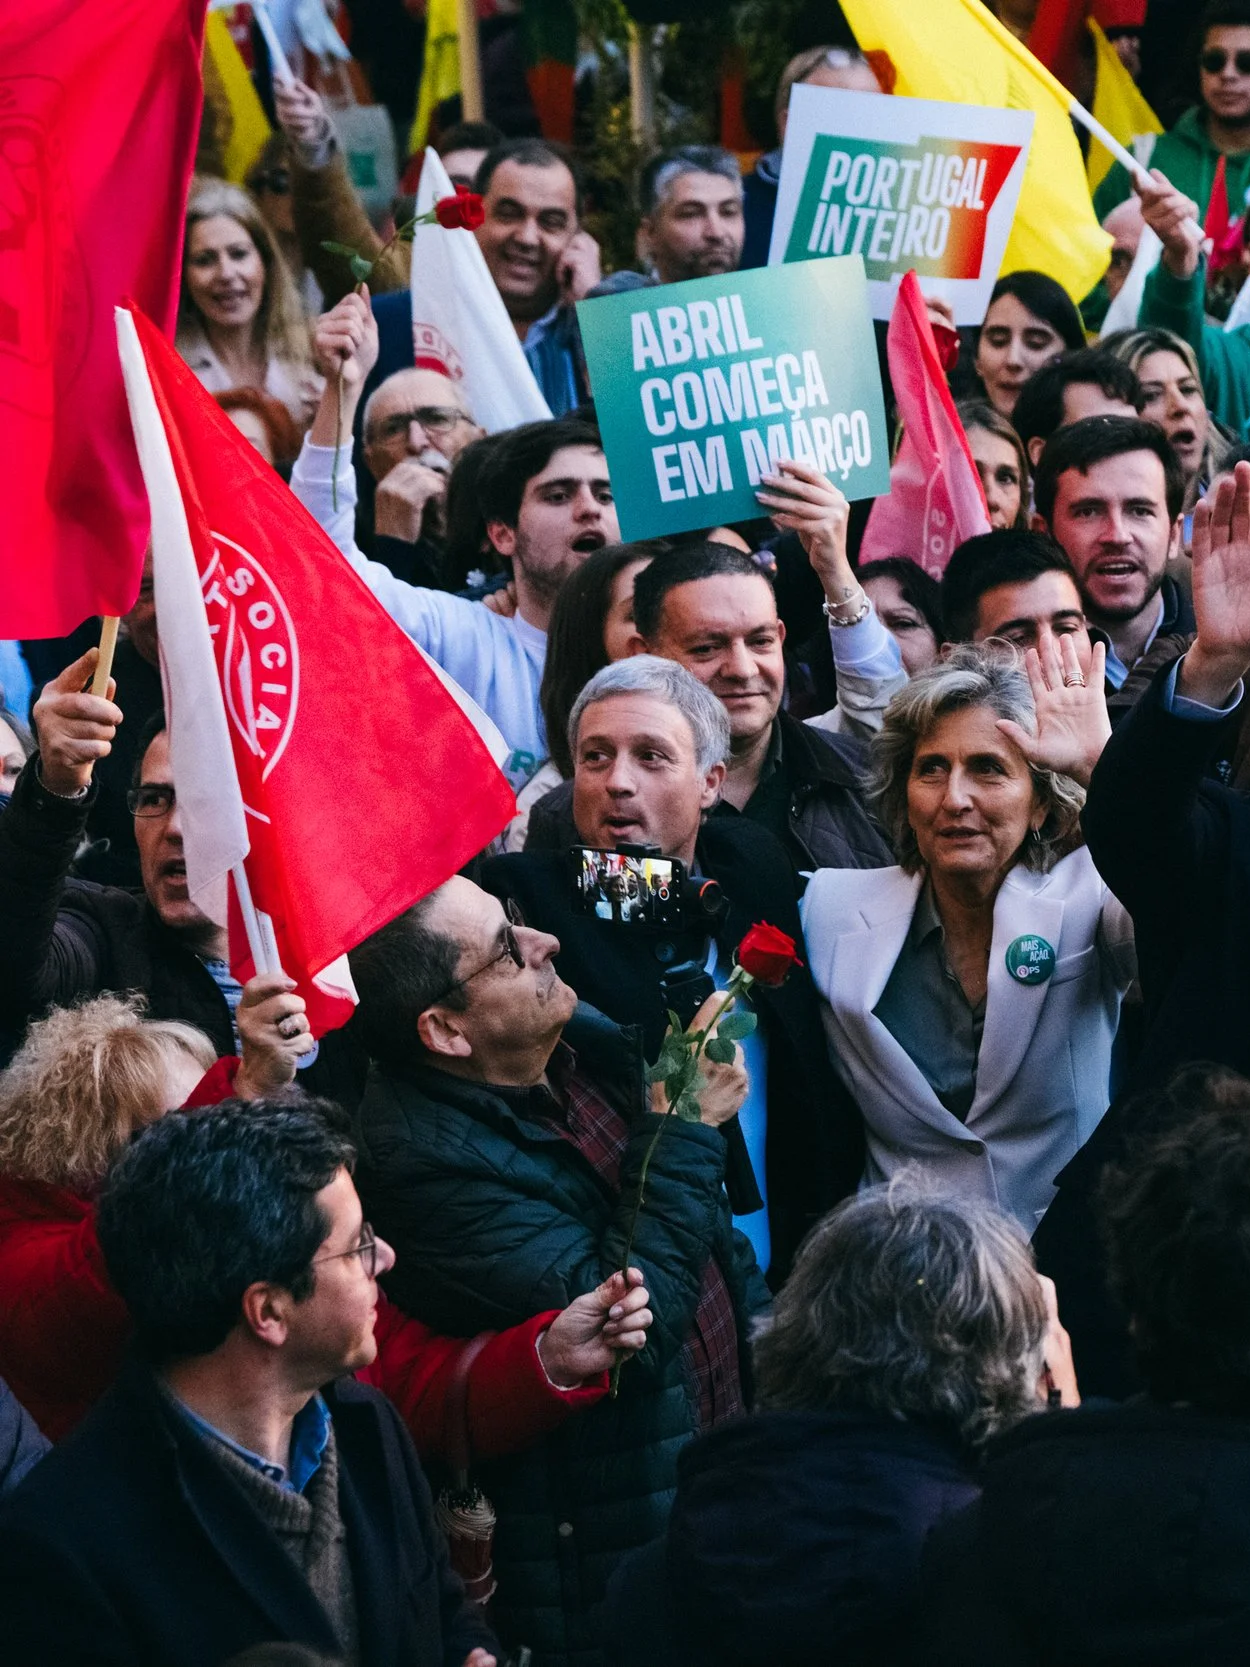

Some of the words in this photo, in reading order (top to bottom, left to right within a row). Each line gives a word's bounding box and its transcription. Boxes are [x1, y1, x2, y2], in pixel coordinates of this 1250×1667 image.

[819, 150, 987, 211] PORTUGAL
[807, 201, 951, 262] INTEIRO
[630, 293, 763, 372] ABRIL
[640, 349, 830, 437] COMEÇA
[651, 434, 733, 503] EM
[740, 409, 872, 487] MARÇO
[1021, 940, 1039, 952] MAIS
[1029, 966, 1040, 974] PS
